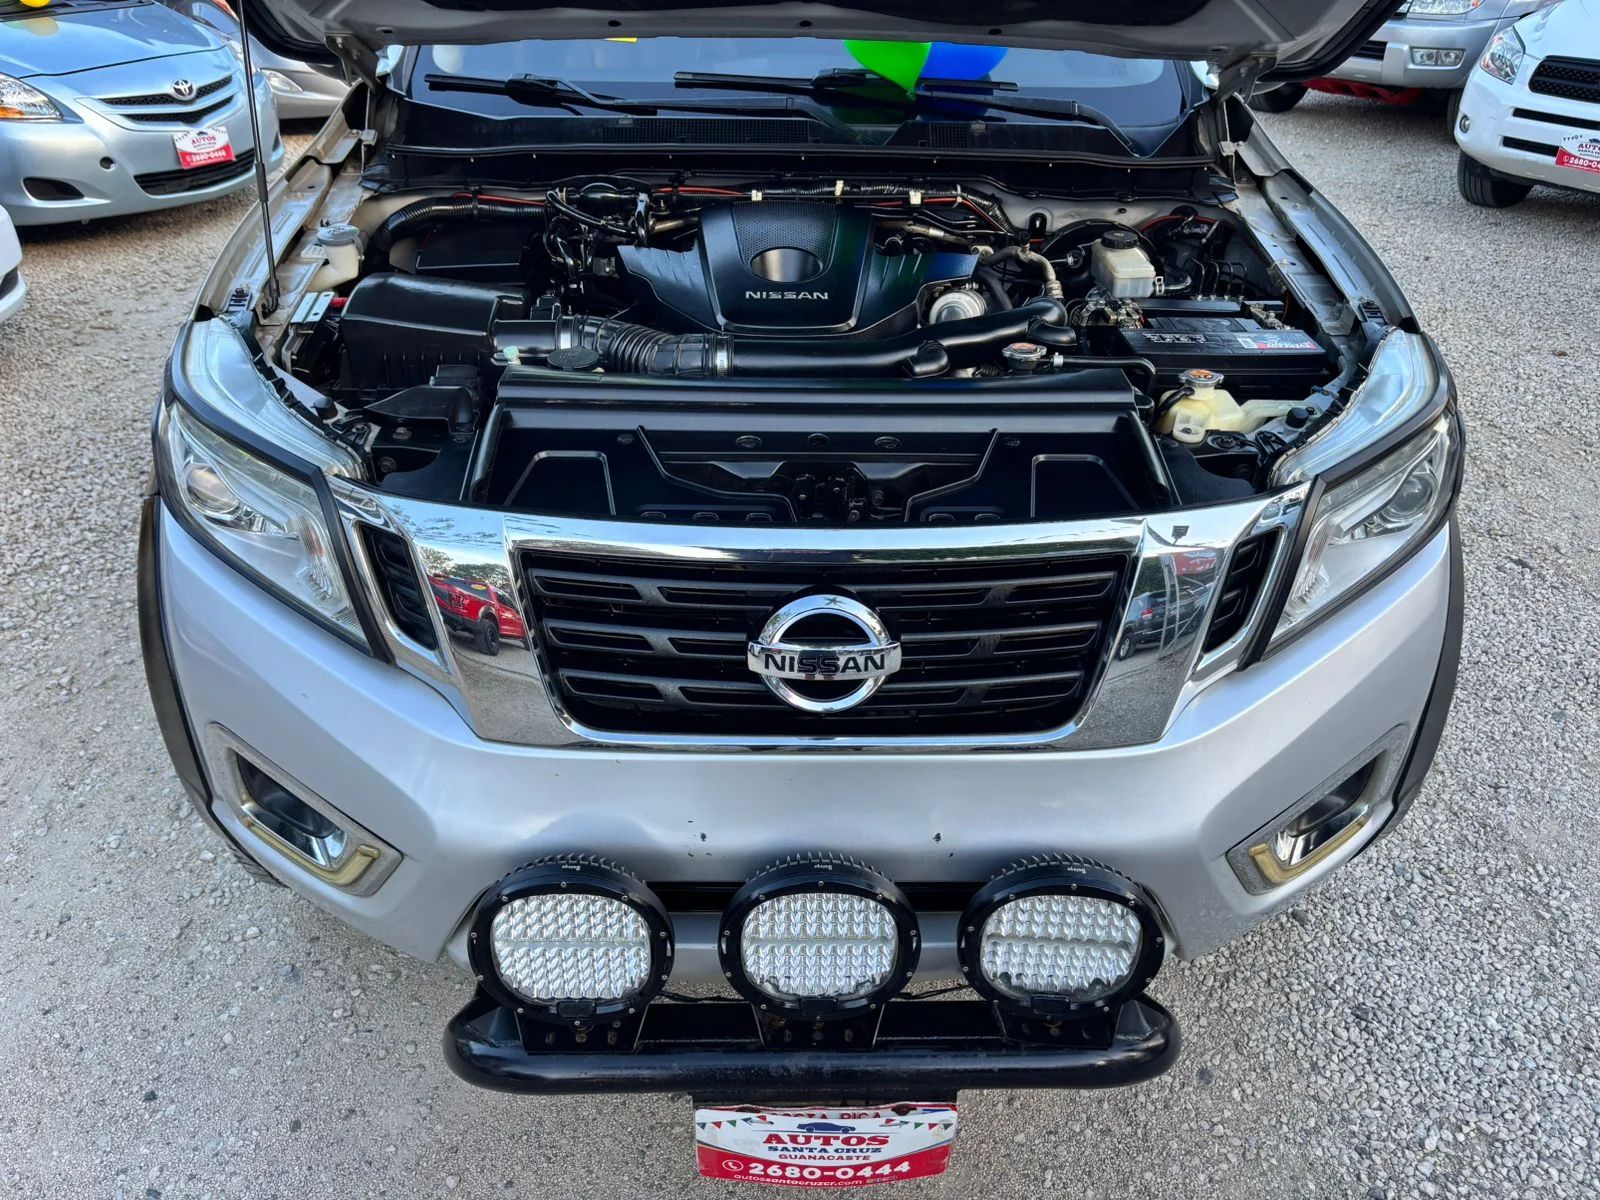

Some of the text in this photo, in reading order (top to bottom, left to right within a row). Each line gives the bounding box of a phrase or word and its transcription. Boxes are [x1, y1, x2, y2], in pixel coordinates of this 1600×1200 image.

[745, 291, 828, 300] NISSAN
[764, 653, 885, 675] NISSAN
[763, 1133, 890, 1146] AUTOS
[749, 1161, 910, 1179] 2680-0444
[734, 1174, 862, 1186] autossantacruzcr.com
